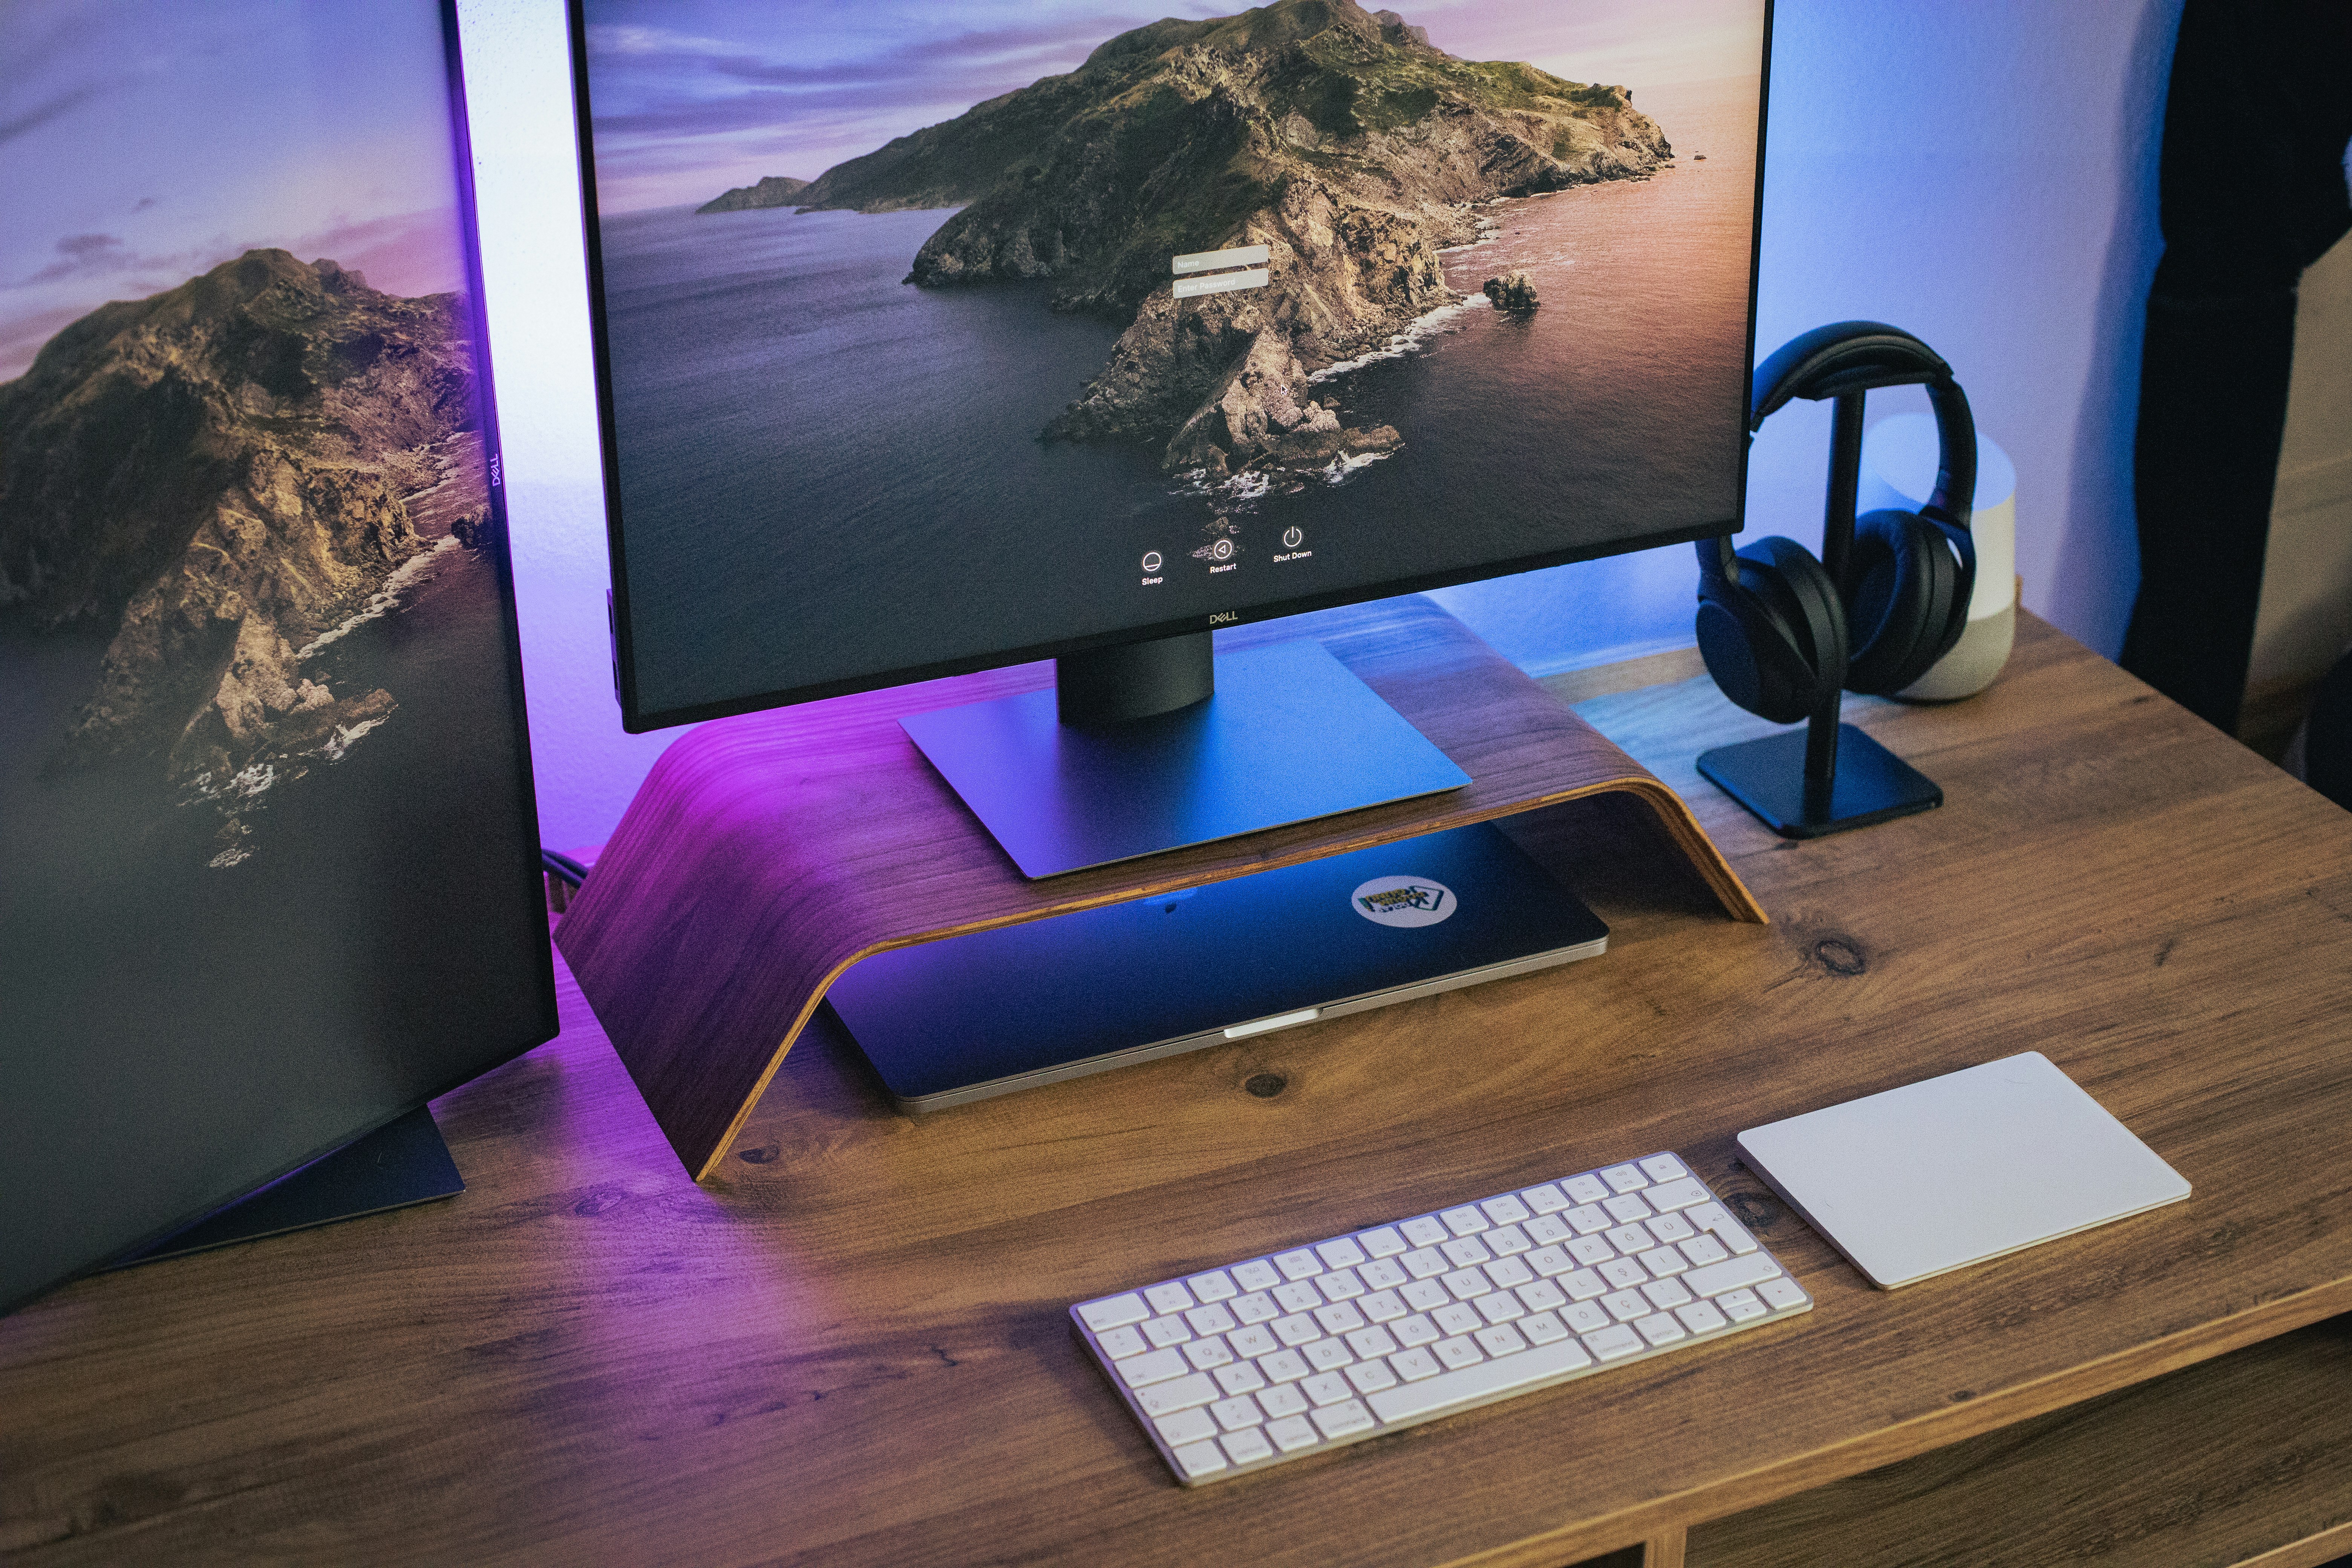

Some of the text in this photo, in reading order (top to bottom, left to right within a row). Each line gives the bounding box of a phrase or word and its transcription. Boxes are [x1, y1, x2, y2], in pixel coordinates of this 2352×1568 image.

[1178, 260, 1199, 268] Name
[1178, 278, 1236, 293] Enter Password
[490, 453, 501, 486] DELL
[1274, 551, 1312, 562] Shut Down
[1210, 563, 1237, 573] Restart
[1142, 577, 1163, 585] Sleep
[1210, 611, 1238, 624] DELL
[1617, 1268, 1627, 1277] Ş
[1620, 1300, 1630, 1309] Ç
[1599, 1340, 1634, 1352] command
[1202, 1348, 1213, 1356] Q
[1278, 1361, 1288, 1369] S
